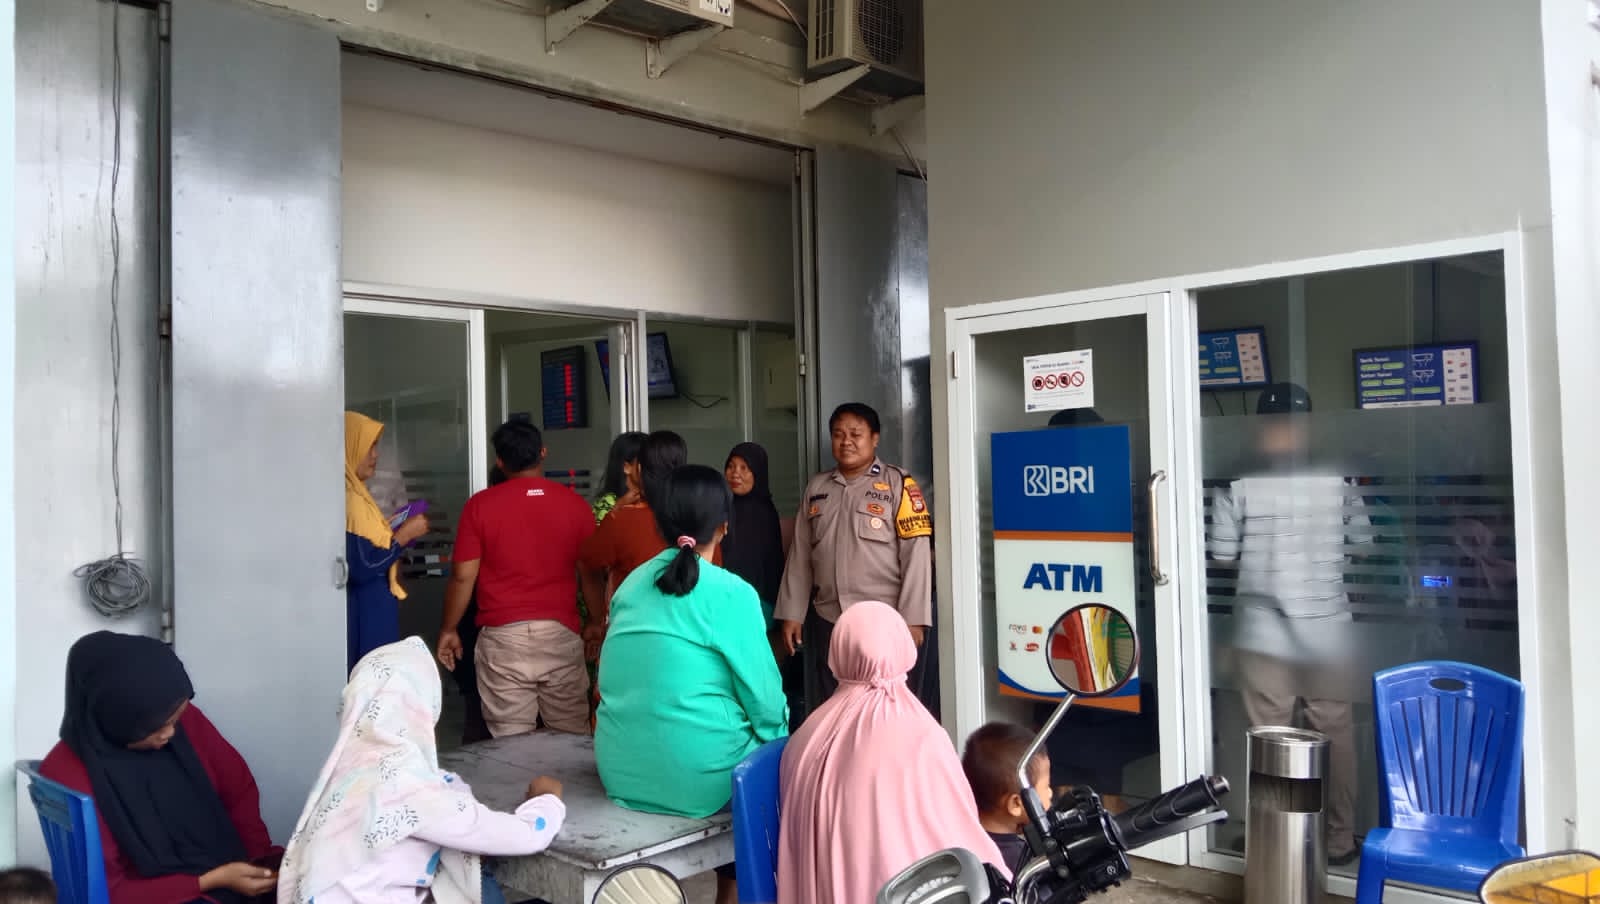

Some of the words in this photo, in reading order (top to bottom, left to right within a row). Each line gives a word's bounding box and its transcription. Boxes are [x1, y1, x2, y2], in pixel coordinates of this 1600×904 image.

[1051, 466, 1095, 494] BRI
[865, 491, 893, 504] POLRI
[1023, 563, 1103, 594] ATM
